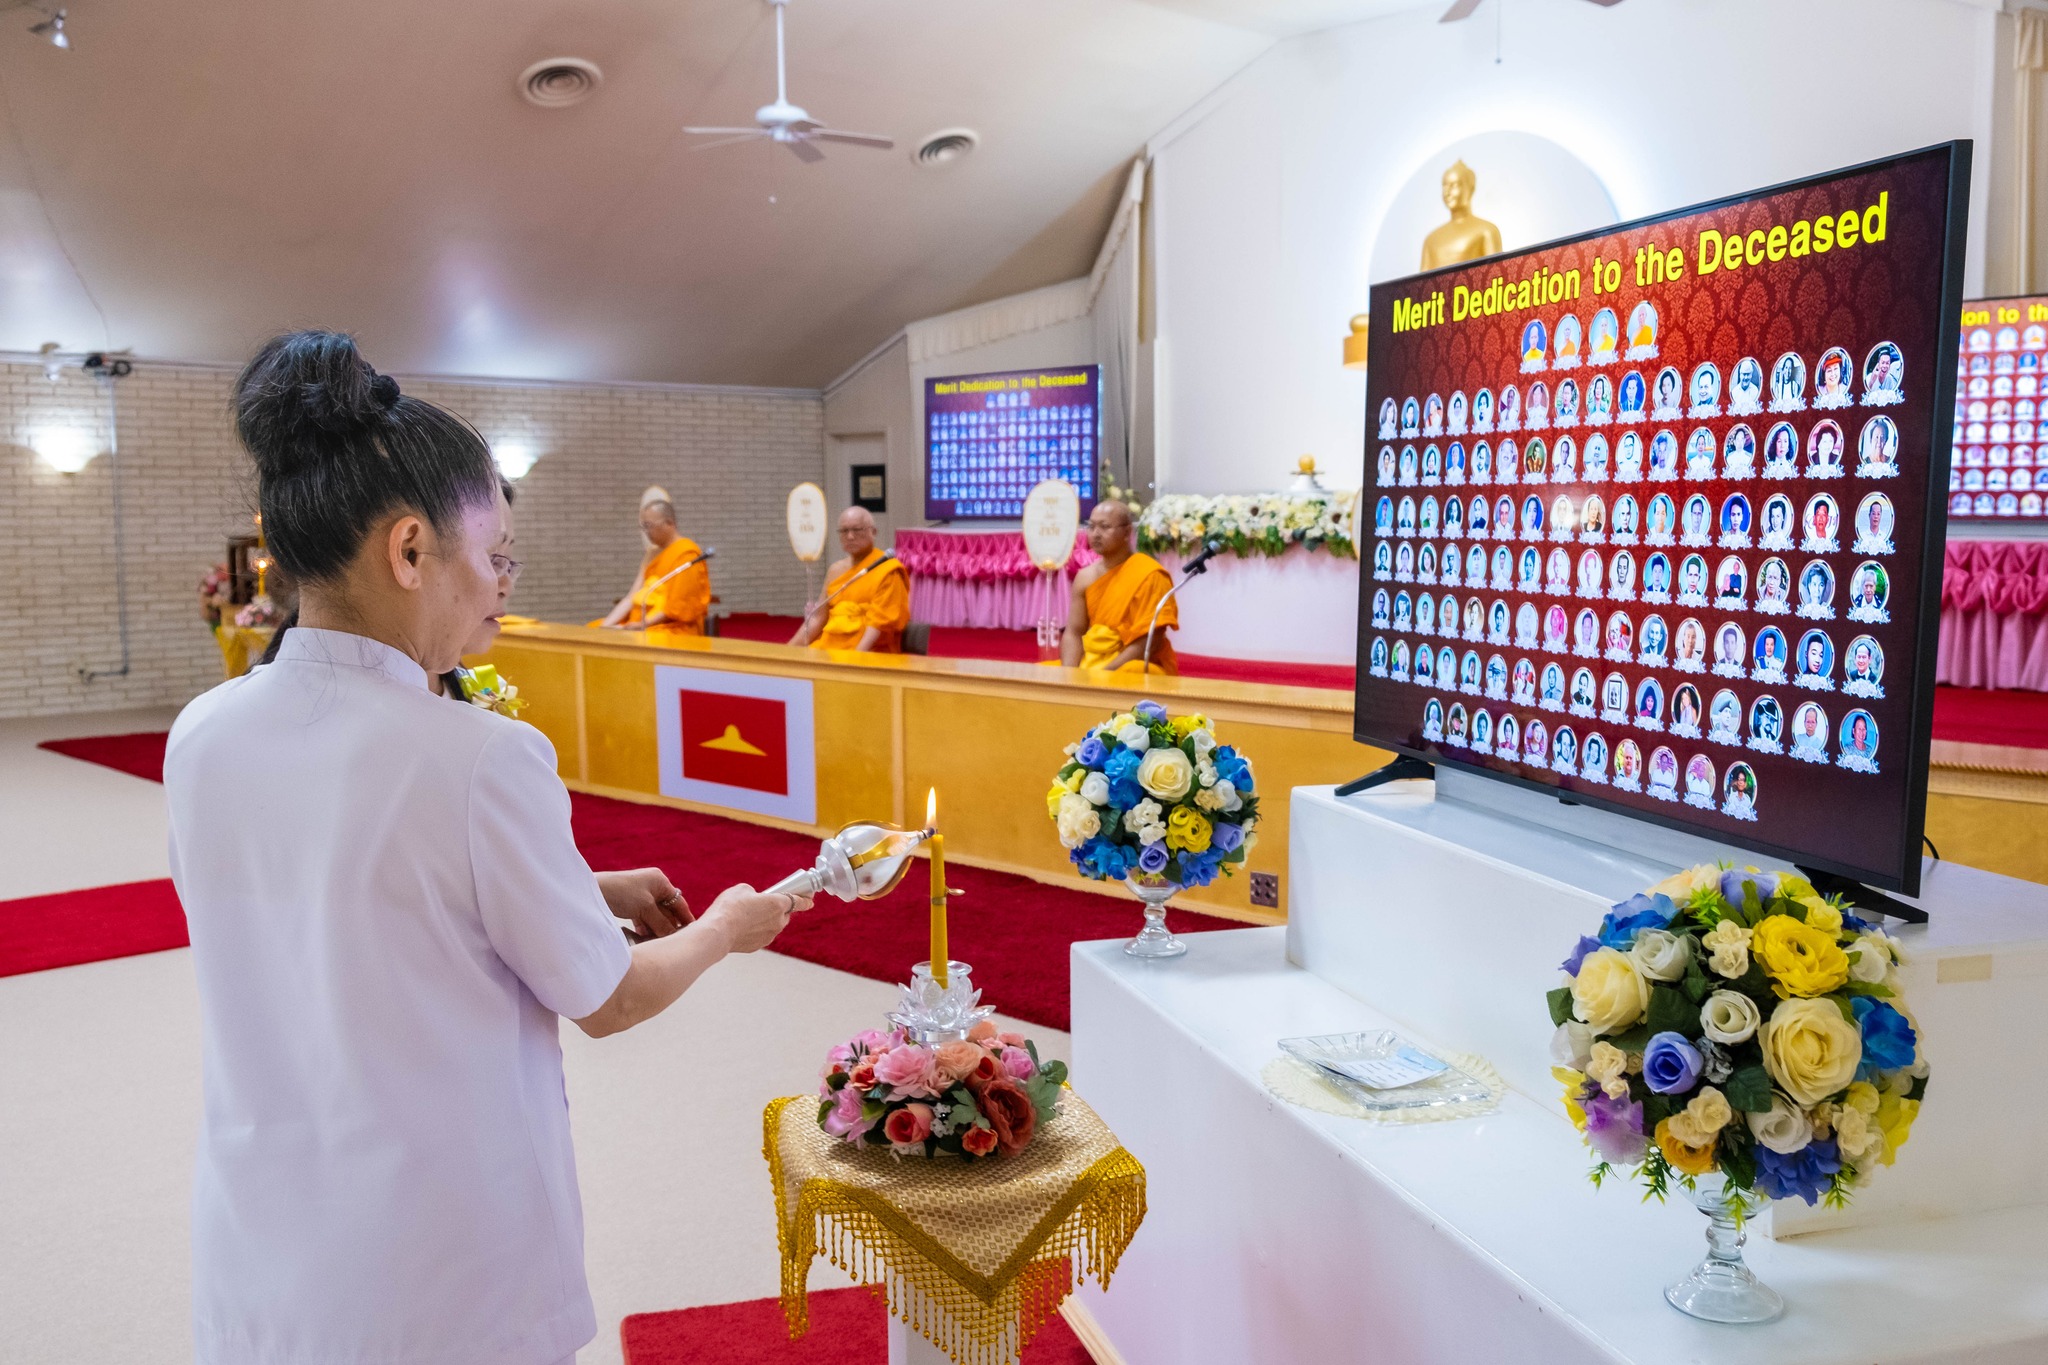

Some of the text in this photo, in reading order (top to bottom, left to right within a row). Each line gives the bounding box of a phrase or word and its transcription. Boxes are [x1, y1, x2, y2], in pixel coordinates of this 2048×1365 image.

[1392, 191, 1888, 334] Merit Dedication to the Deceased
[1997, 306, 2021, 325] to
[935, 372, 1087, 394] Merit Dedication to the Deceased
